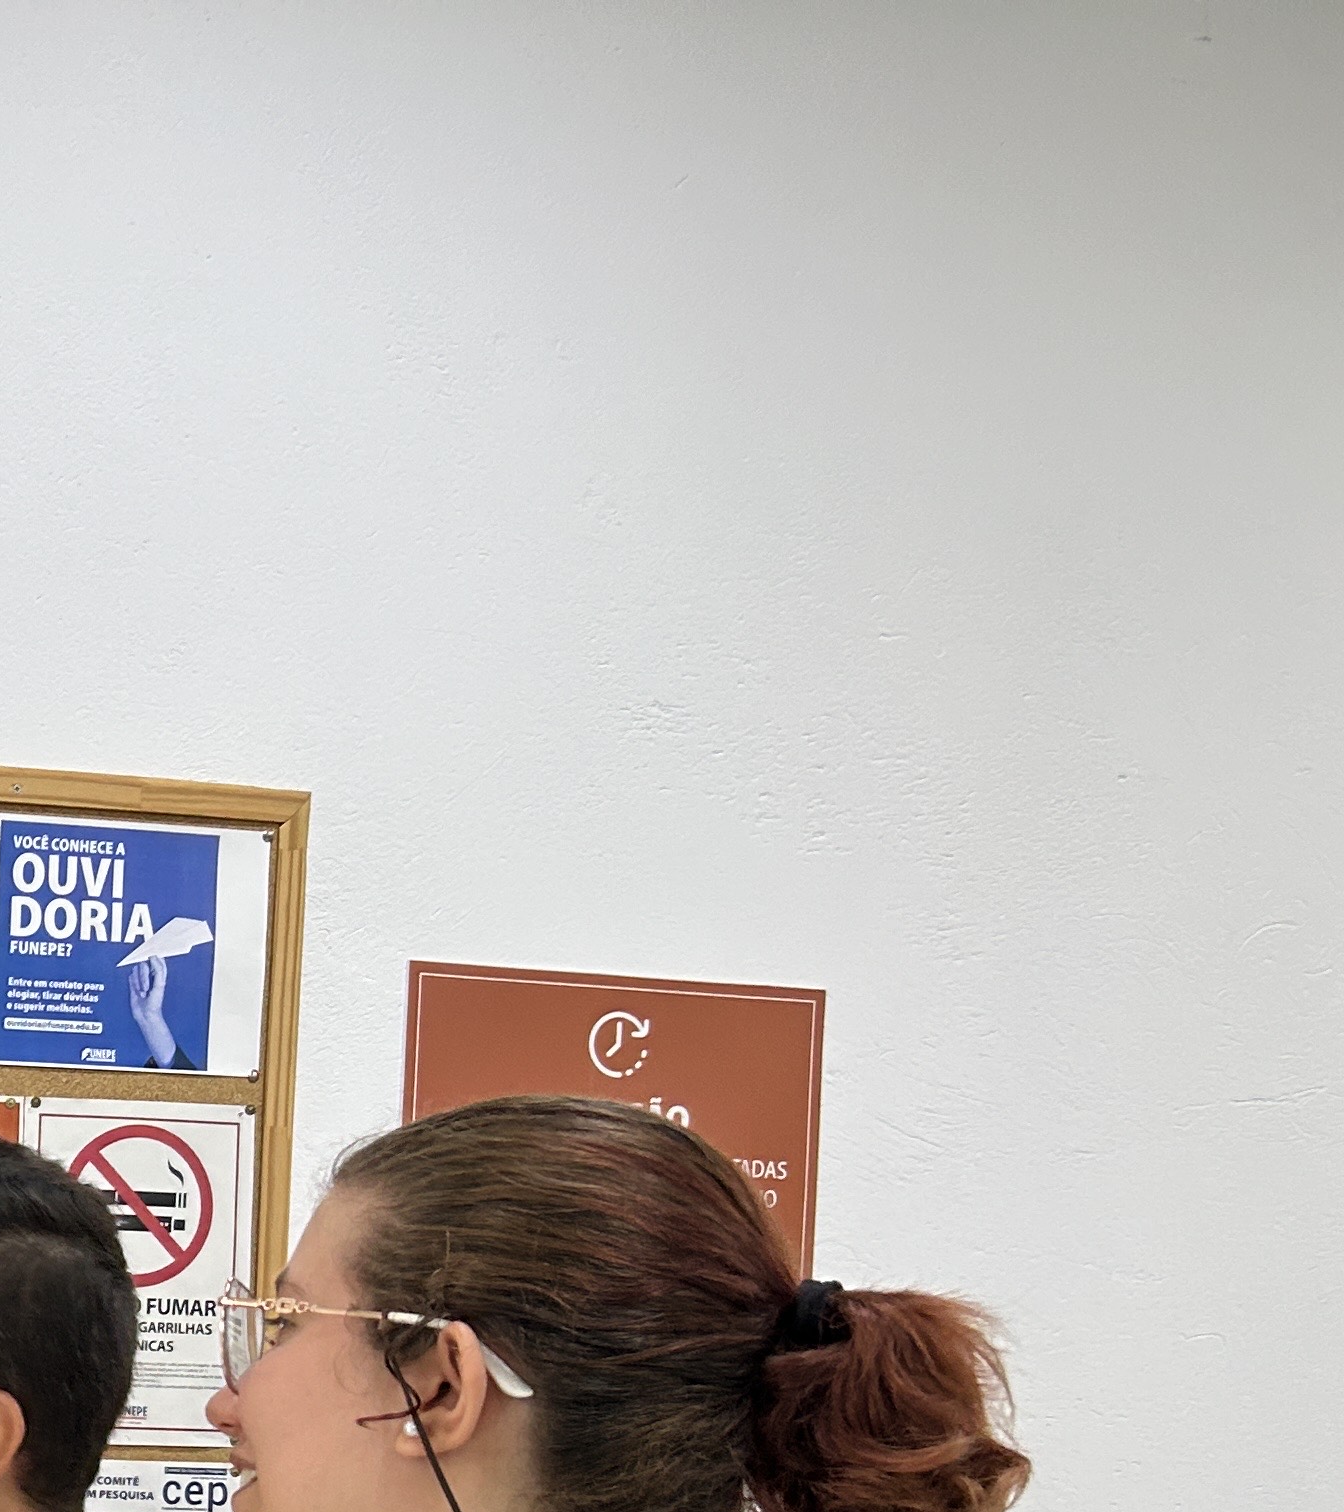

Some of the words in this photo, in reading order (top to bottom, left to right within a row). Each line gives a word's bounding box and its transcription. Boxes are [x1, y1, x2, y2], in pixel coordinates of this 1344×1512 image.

[14, 834, 49, 850] VOCÊ
[52, 838, 113, 854] CONHECE
[116, 842, 125, 855] A
[13, 852, 124, 899] OUVI
[10, 895, 154, 943] DORIA
[10, 940, 72, 957] FUNEPE?
[8, 977, 32, 986] Entre
[49, 981, 83, 989] contato
[84, 983, 104, 991] para
[7, 989, 40, 1000] elogiar,
[43, 991, 62, 1000] tirar
[64, 993, 99, 1002] dúvidas
[14, 1002, 45, 1013] sugerir
[47, 1003, 93, 1014] melhorias.
[81, 1048, 116, 1060] FUNEPE
[147, 1298, 216, 1316] FUMAR
[138, 1322, 212, 1335] GARRILHAS
[136, 1340, 174, 1352] NICAS
[124, 1406, 147, 1416] NEPE
[97, 1476, 139, 1486] COMITÊ
[87, 1490, 96, 1498] M
[99, 1490, 154, 1501] PESQUISA
